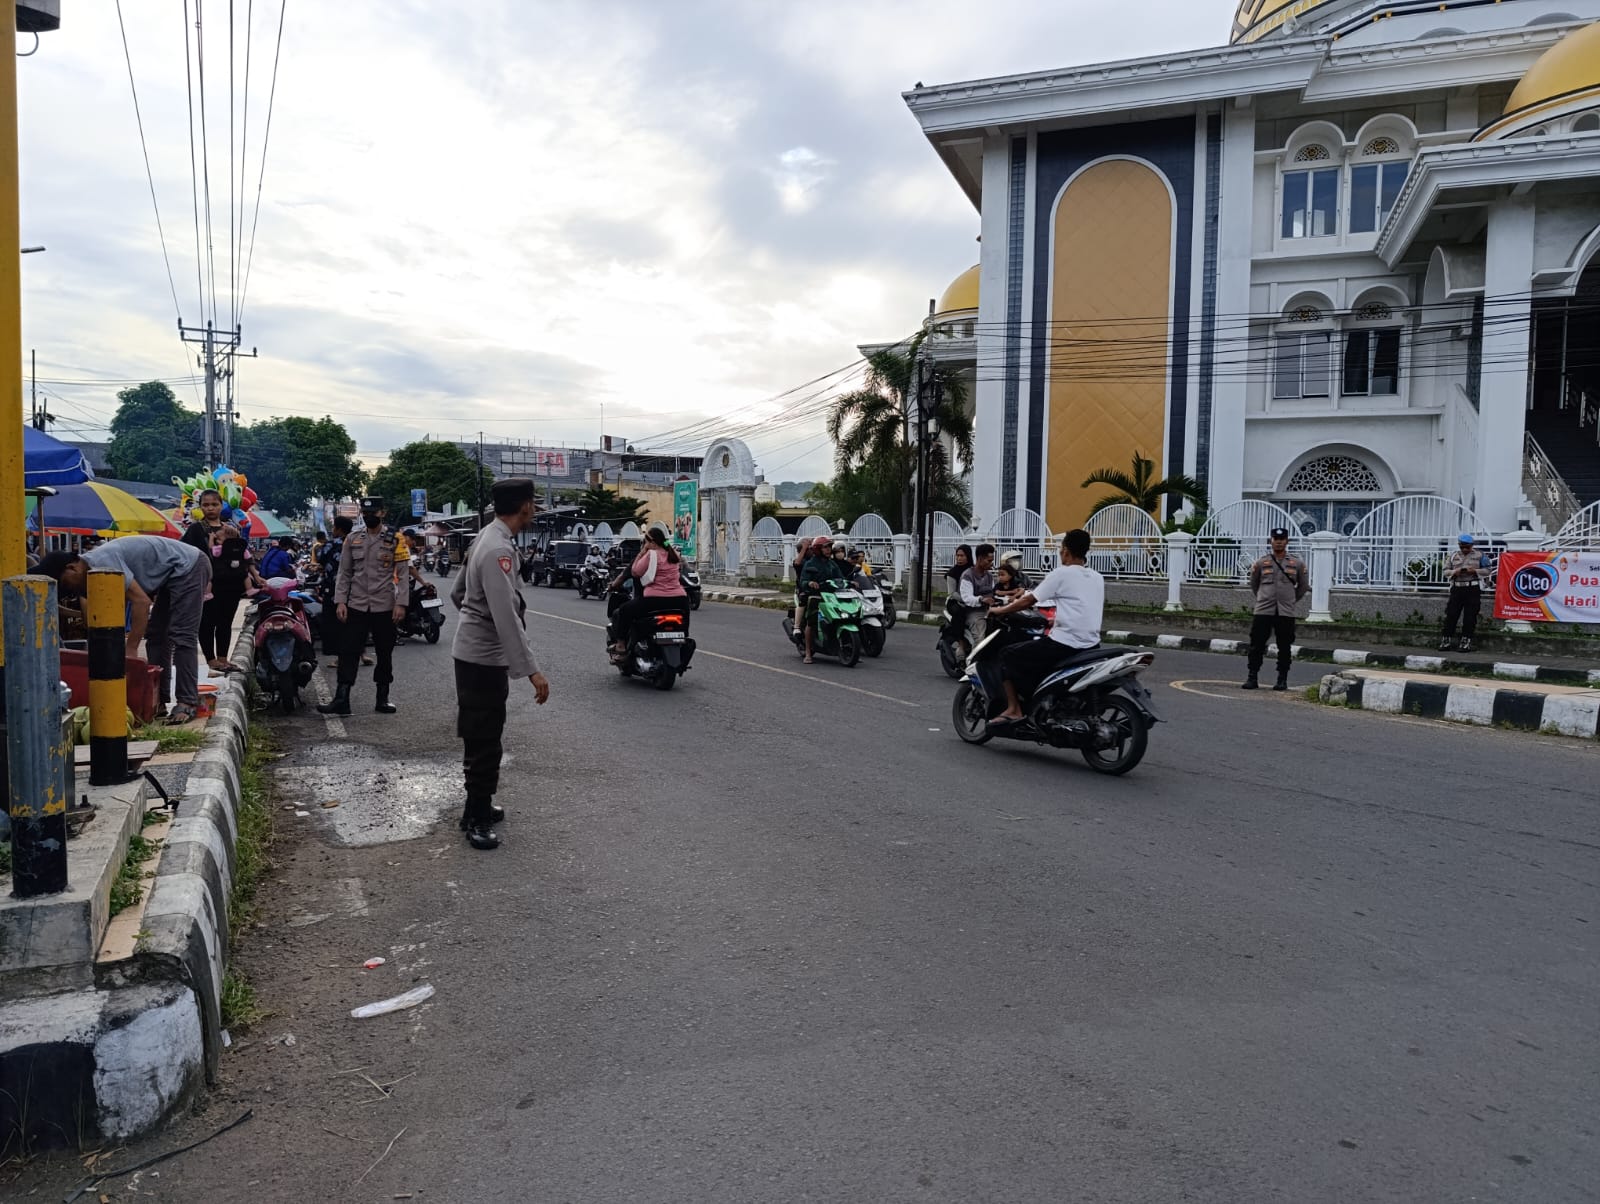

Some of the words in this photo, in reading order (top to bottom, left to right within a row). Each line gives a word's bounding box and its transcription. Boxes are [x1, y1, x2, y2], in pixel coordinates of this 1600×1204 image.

[1519, 573, 1549, 591] Cleo
[1569, 574, 1599, 586] Pua
[1564, 595, 1597, 607] Hari
